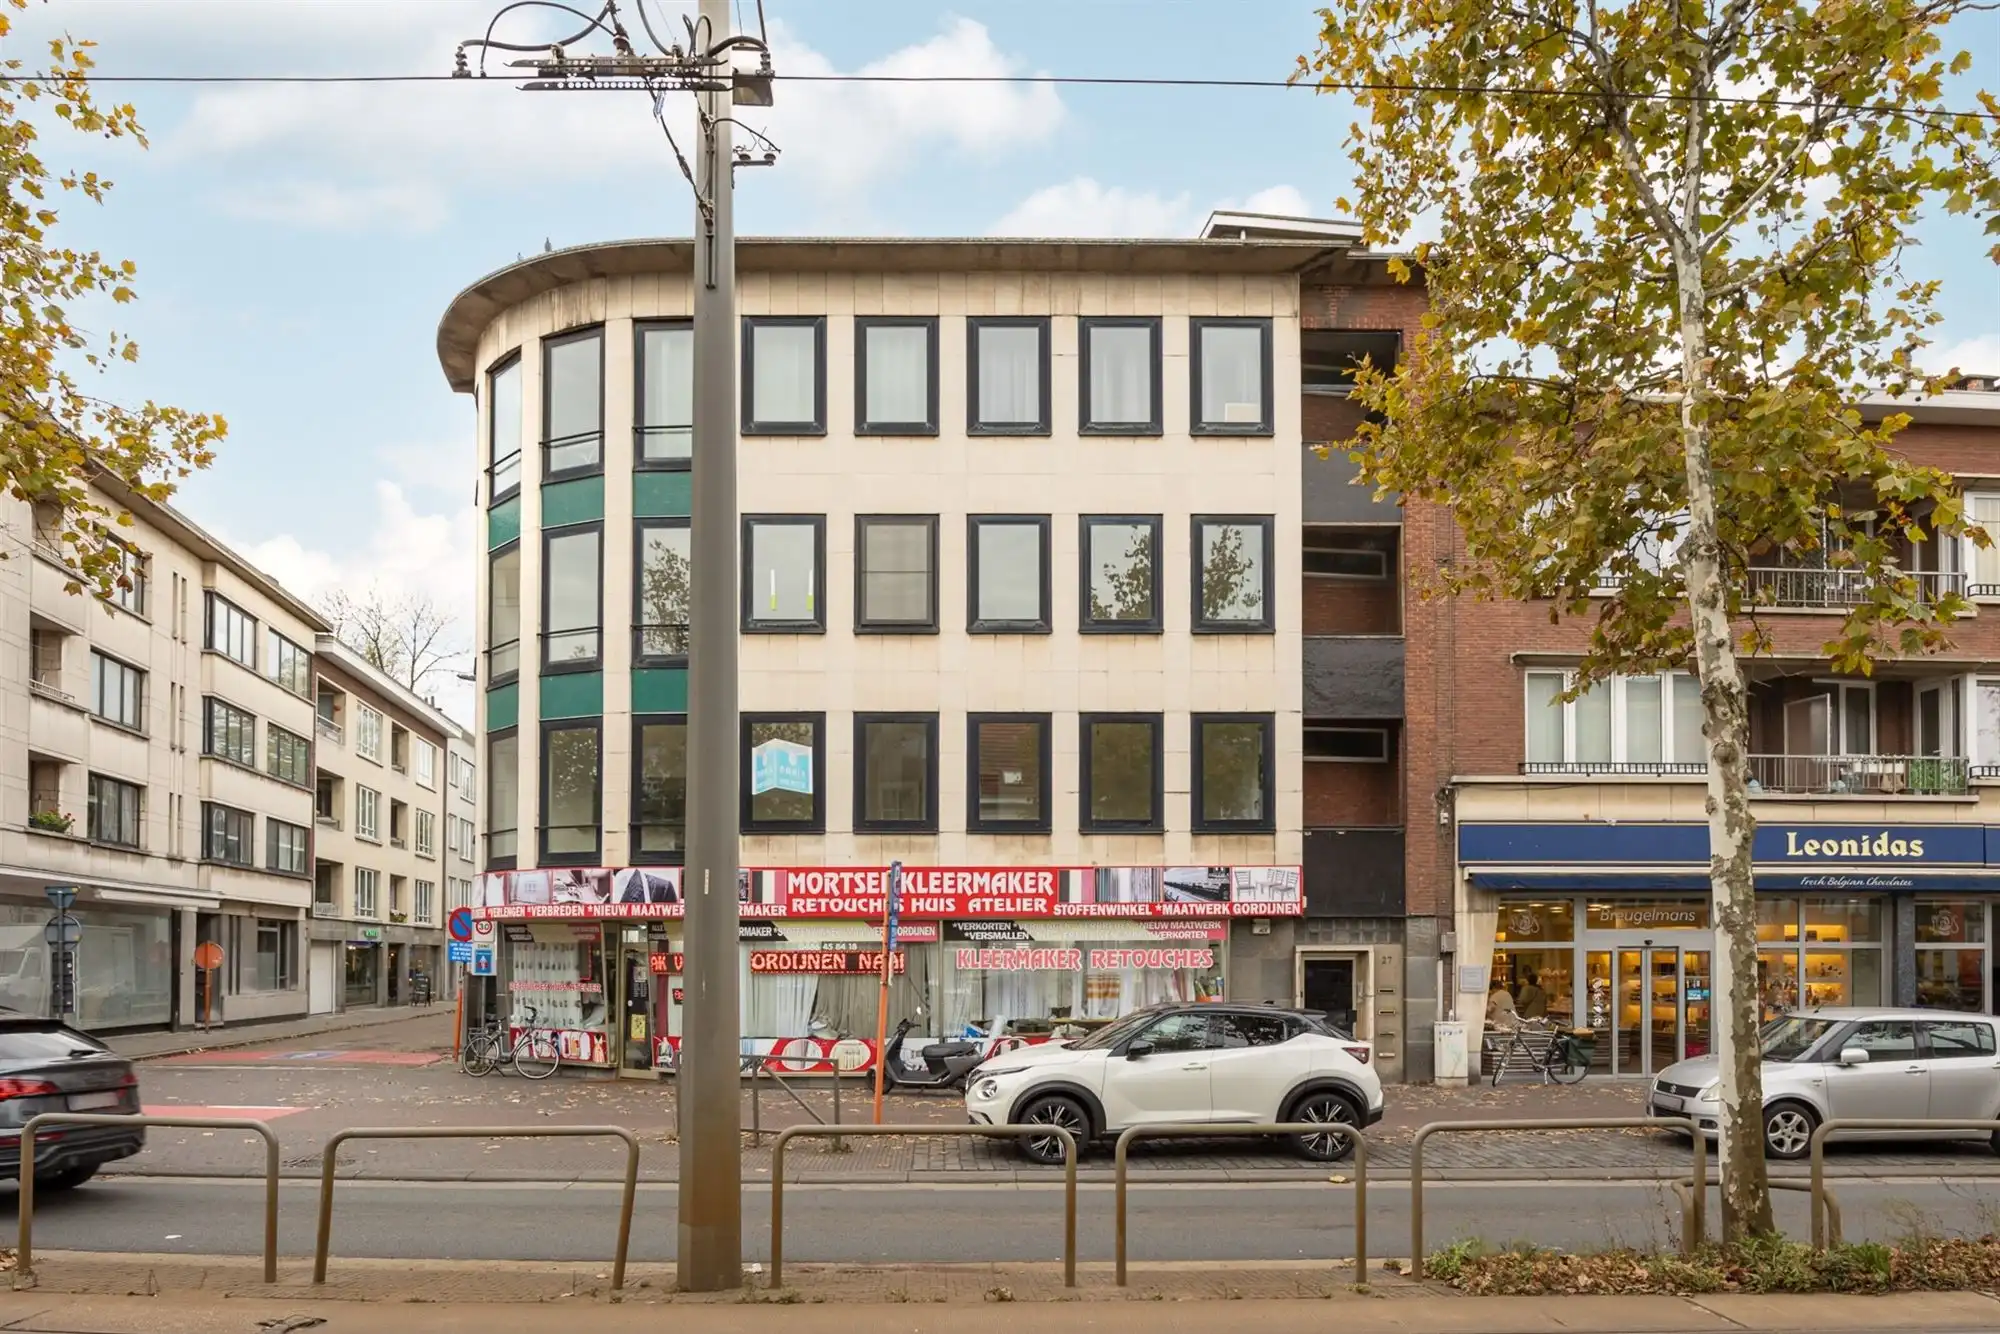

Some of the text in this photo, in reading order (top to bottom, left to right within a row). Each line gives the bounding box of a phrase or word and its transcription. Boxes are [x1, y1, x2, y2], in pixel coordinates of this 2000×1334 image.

[1786, 831, 1924, 857] Leonidas
[900, 871, 1054, 896] KLEERMAKER
[1800, 876, 1826, 886] Fresh
[1827, 876, 1865, 888] Belgian
[631, 904, 685, 917] MAATWER
[739, 905, 787, 917] RMAKER
[911, 898, 956, 913] HUIS
[968, 897, 1048, 913] ATELIER
[1053, 904, 1152, 916] STOFFENWINKEL
[1233, 903, 1300, 915] GORDIJNEN
[1600, 908, 1696, 925] Breugelmans
[739, 927, 772, 937] RMAKER
[897, 926, 936, 936] ORDIJNEN
[1170, 920, 1222, 930] MAATWERK
[956, 948, 1214, 971] KLEERMAKER RETOUCHES
[1381, 956, 1392, 965] 27
